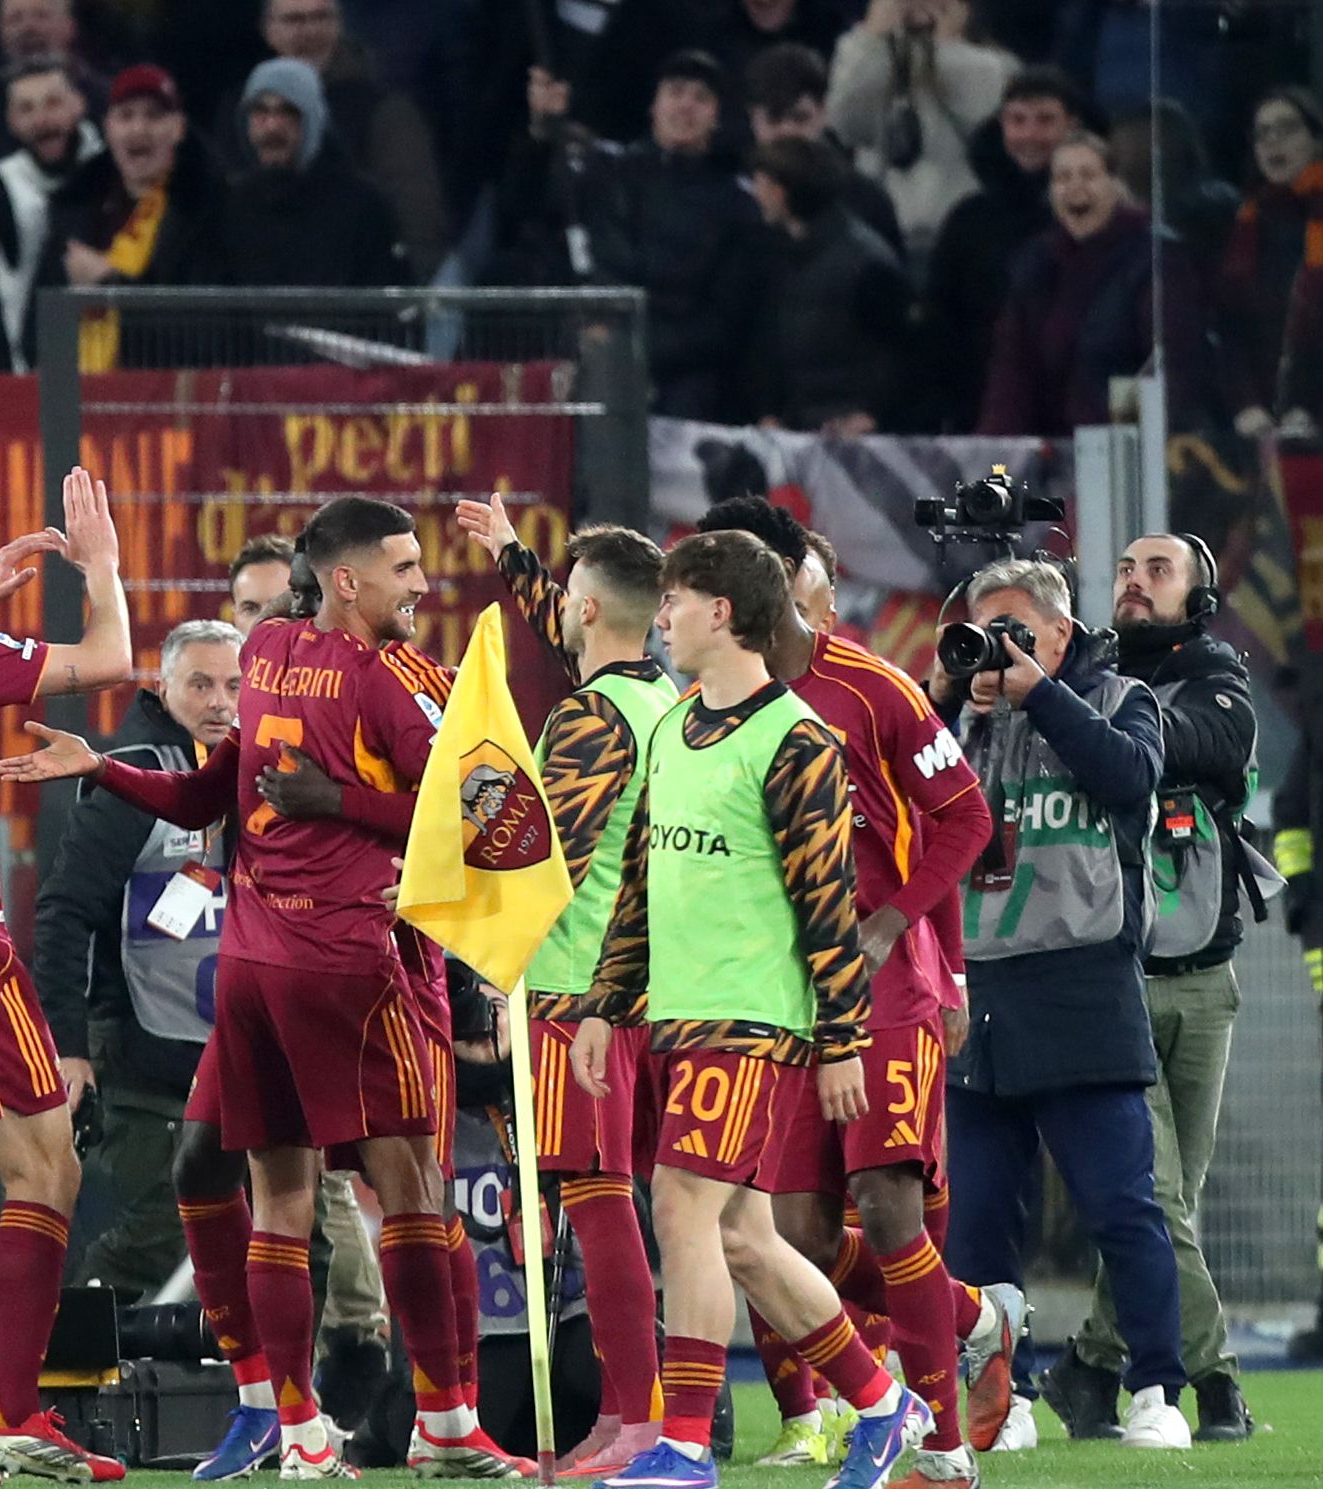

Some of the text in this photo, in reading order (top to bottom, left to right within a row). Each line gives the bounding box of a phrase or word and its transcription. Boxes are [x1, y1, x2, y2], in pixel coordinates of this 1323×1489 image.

[480, 793, 537, 865] ROMA
[517, 824, 539, 855] 1927
[665, 1060, 731, 1122] 20
[886, 1060, 916, 1114] 5
